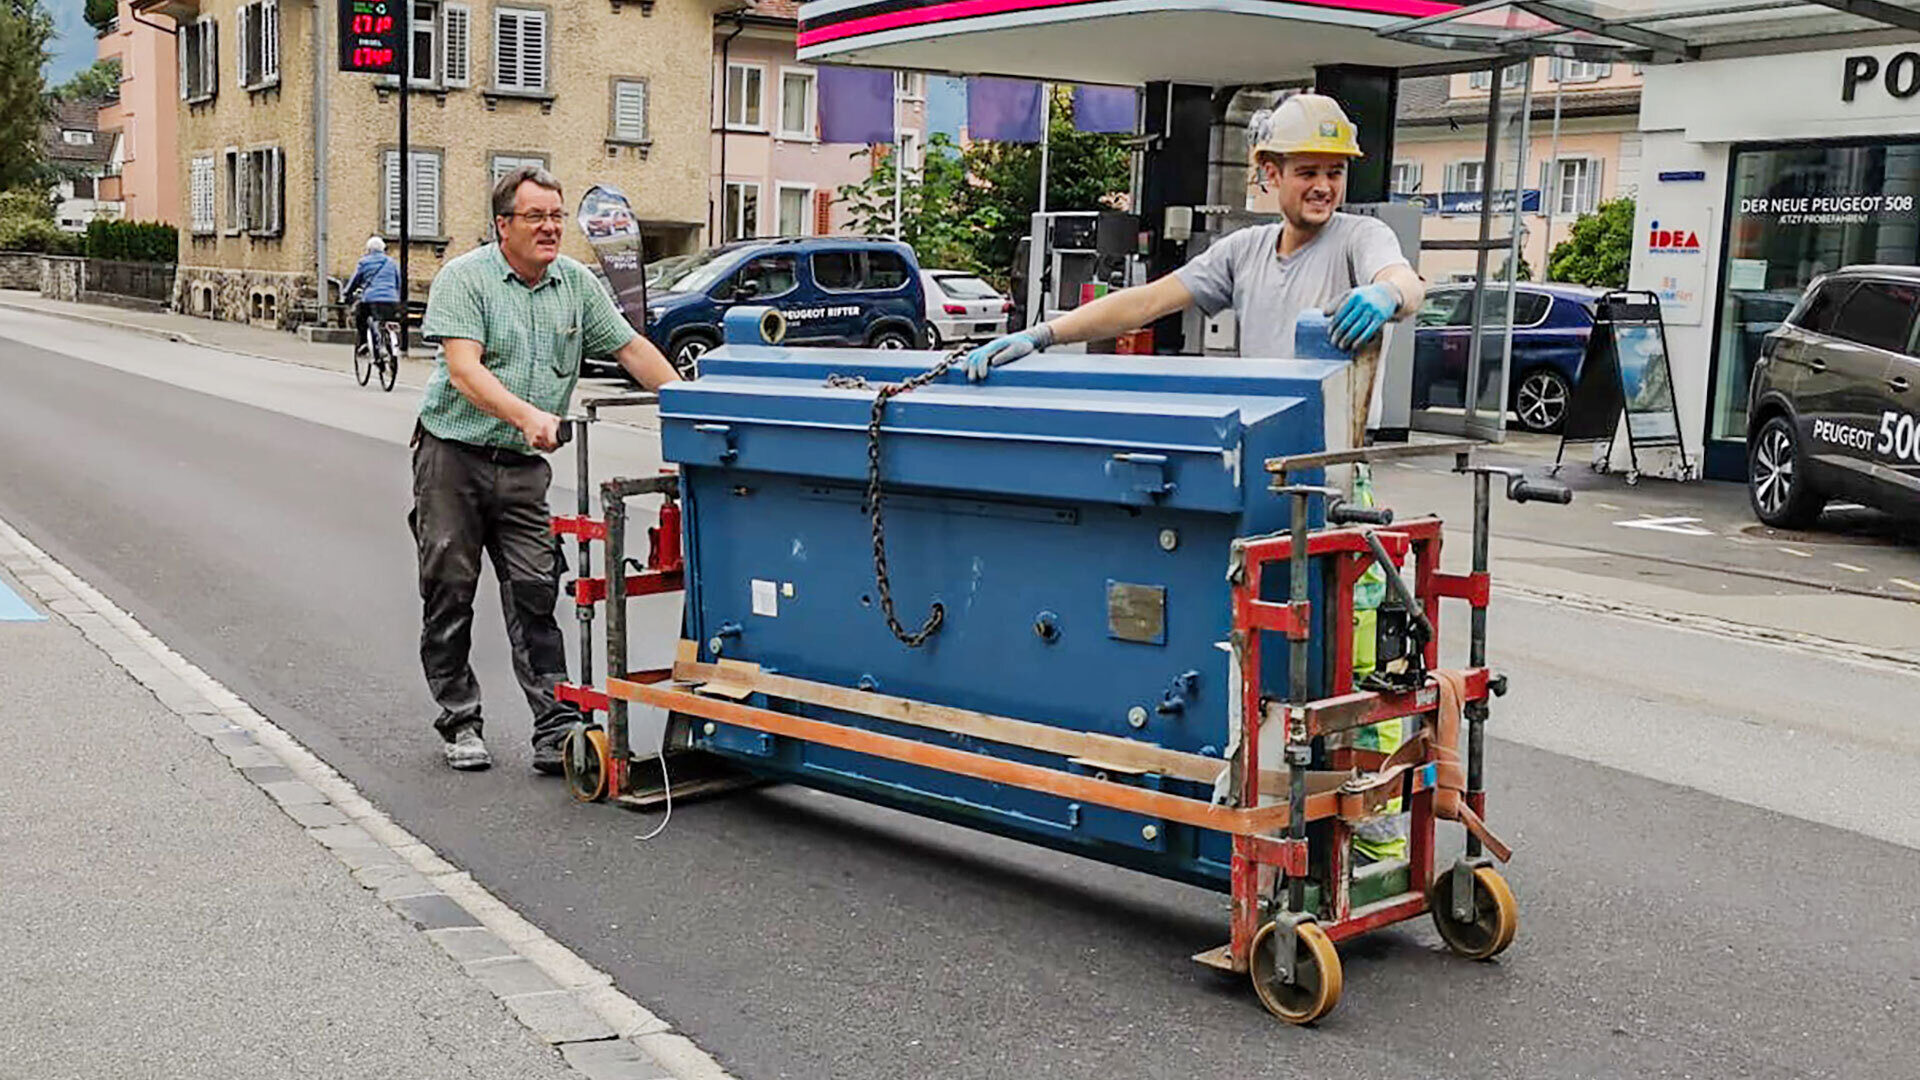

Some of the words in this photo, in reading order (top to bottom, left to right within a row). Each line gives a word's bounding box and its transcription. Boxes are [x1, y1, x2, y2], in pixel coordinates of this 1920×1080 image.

[1841, 52, 1920, 102] PO
[1741, 199, 1768, 213] DER
[1771, 198, 1809, 212] NEUE
[1812, 197, 1883, 212] PEUGEOT
[1884, 196, 1913, 211] 508
[827, 306, 860, 317] RIFTER
[1813, 419, 1875, 450] PEUGEOT
